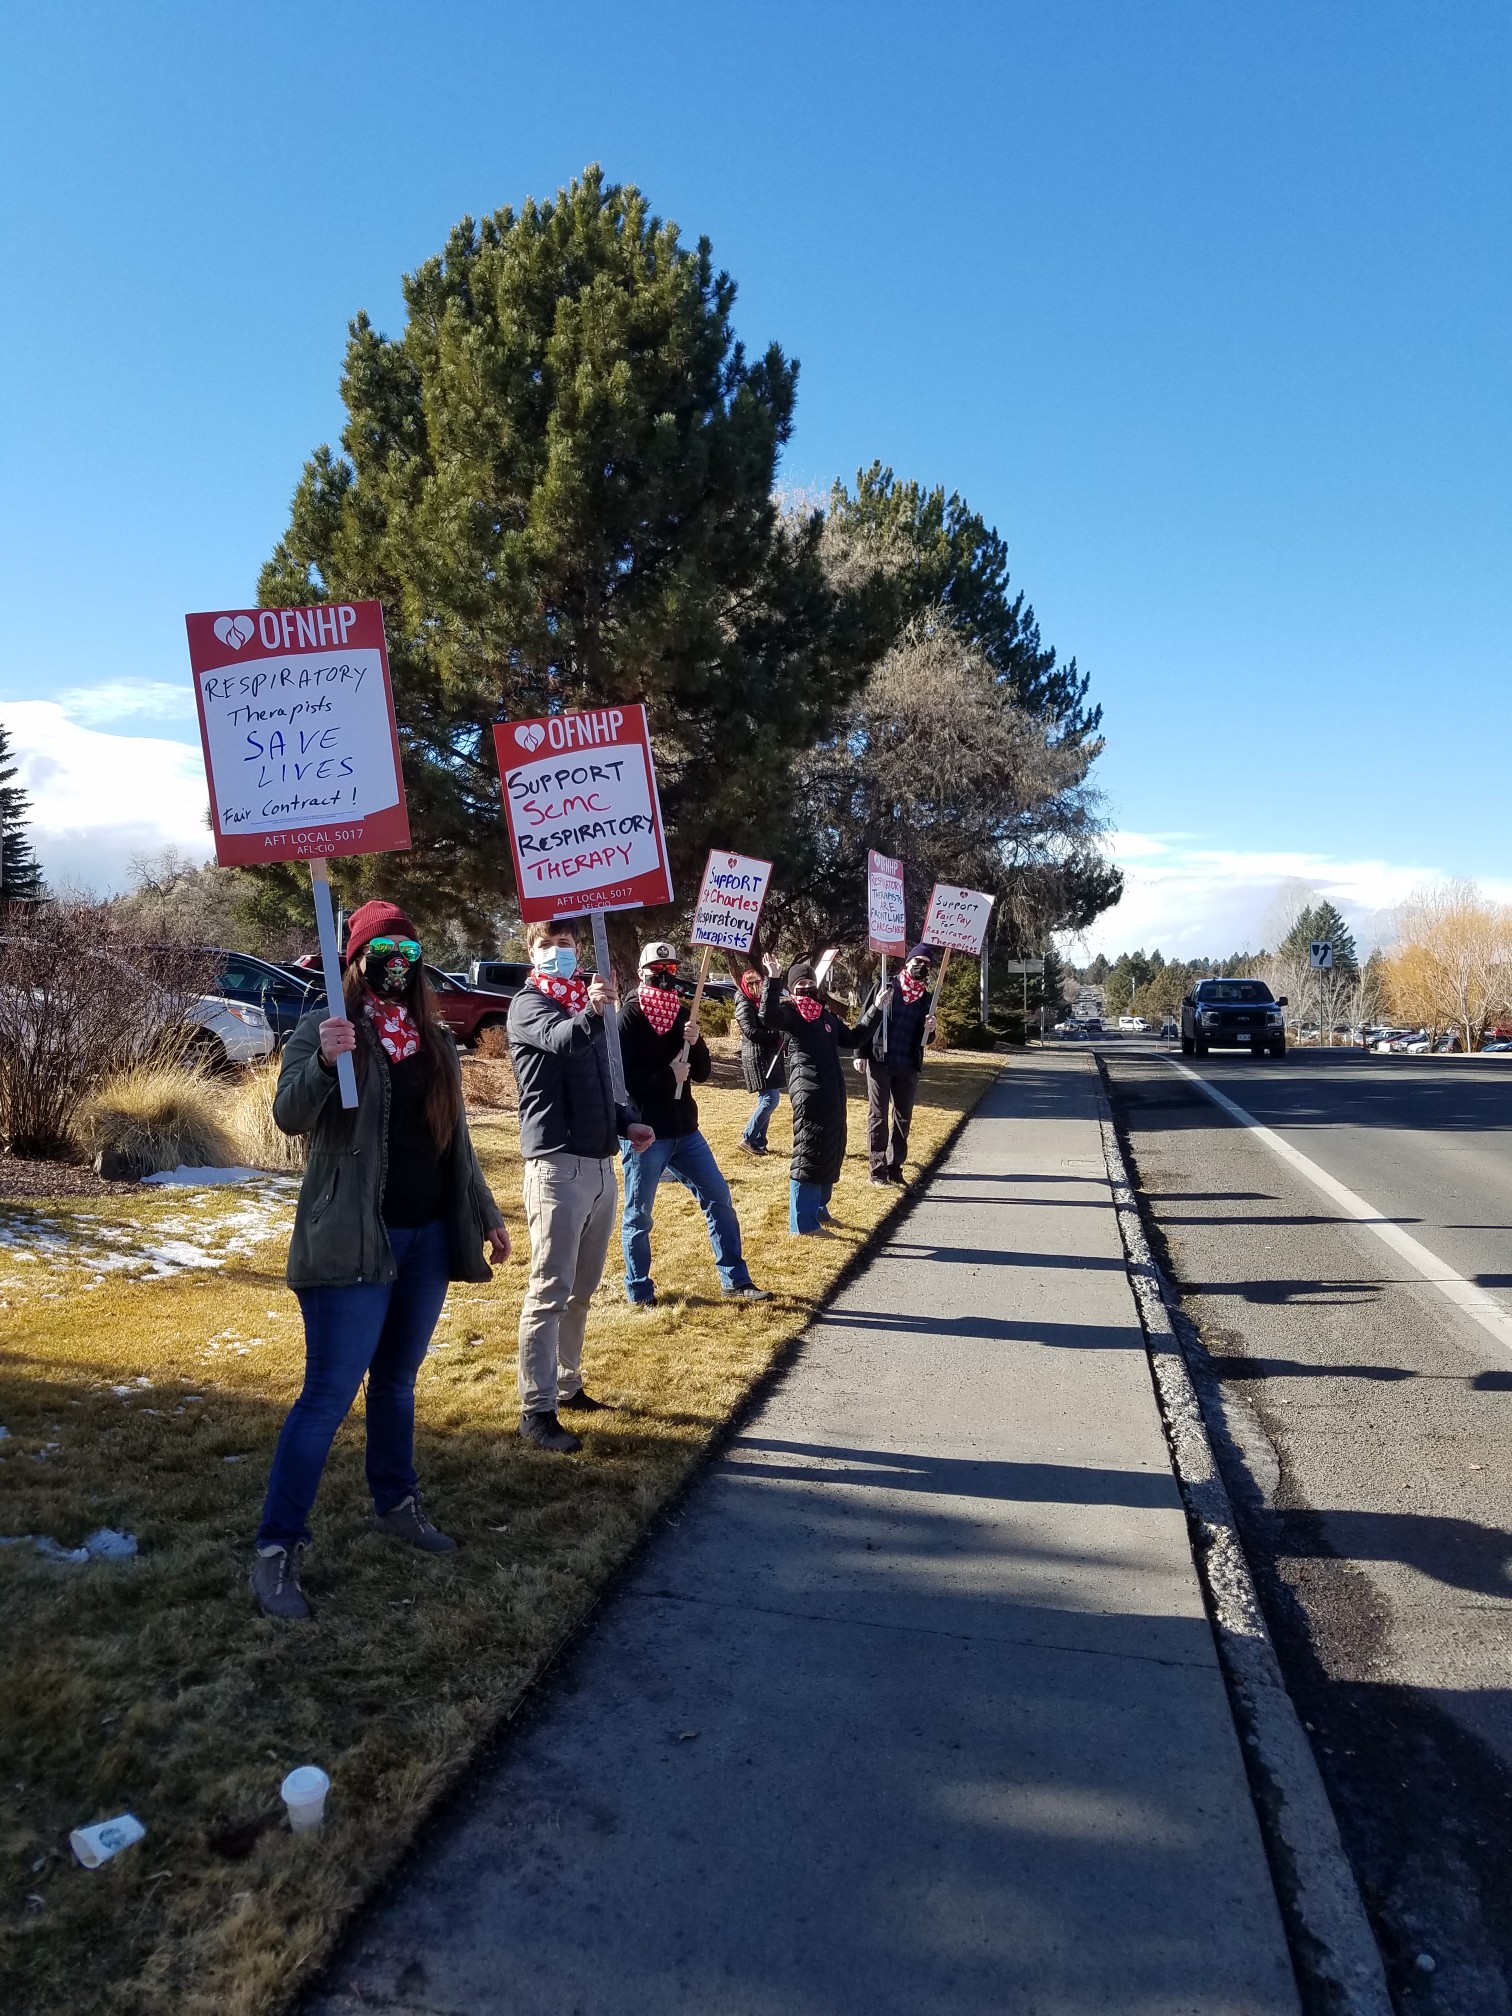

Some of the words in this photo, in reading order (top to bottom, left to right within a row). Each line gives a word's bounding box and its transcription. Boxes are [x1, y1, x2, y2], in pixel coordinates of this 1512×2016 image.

[259, 606, 357, 649] OFNHP
[204, 664, 368, 702] RESPIRATORY
[226, 695, 333, 727] Therapists
[547, 710, 624, 749] OFNHP
[243, 727, 341, 762] SAVE
[257, 757, 353, 788] LIVES
[507, 761, 624, 800] SUPPORT
[222, 808, 252, 826] Fair
[522, 793, 611, 826] SCMC
[264, 834, 287, 847] AFT
[291, 831, 331, 844] LOCAL
[335, 828, 364, 841] 5017
[518, 814, 655, 857] RESPIRATORY
[297, 843, 335, 855] AFL-CIO
[527, 842, 633, 881] THERAPY
[557, 896, 574, 907] AFT
[576, 892, 608, 904] LOCAL
[610, 887, 633, 899] 5017
[710, 888, 758, 912] Charles
[872, 889, 902, 905] THERAPISTS
[880, 901, 897, 912] ARE
[936, 895, 979, 912] Support
[936, 910, 954, 920] Fair
[956, 913, 972, 928] Pay
[696, 927, 747, 948] Therapists
[926, 926, 978, 944] Respiratory
[931, 936, 978, 953] Therapists
